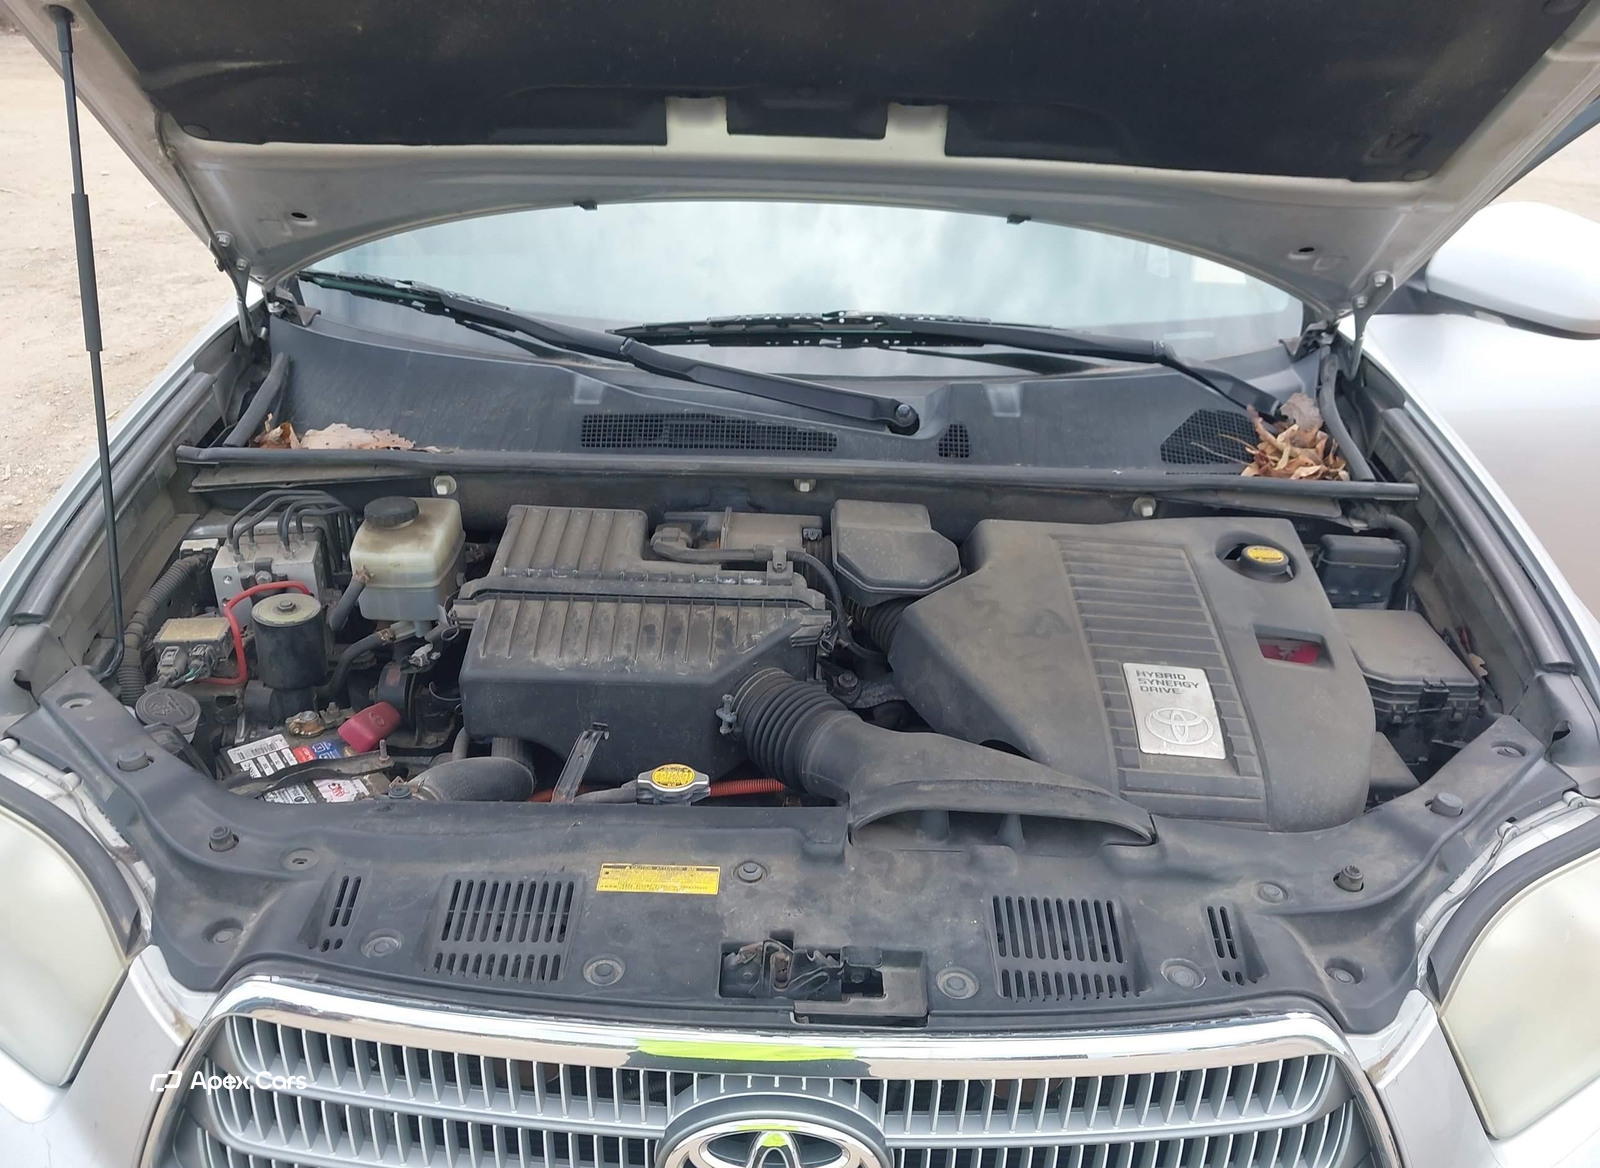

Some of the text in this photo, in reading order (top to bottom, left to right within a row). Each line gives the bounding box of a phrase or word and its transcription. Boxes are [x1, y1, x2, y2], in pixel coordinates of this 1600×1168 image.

[1136, 671, 1186, 680] HYBRID
[1138, 678, 1199, 689] SYNERGY
[1140, 685, 1181, 695] DRIVE
